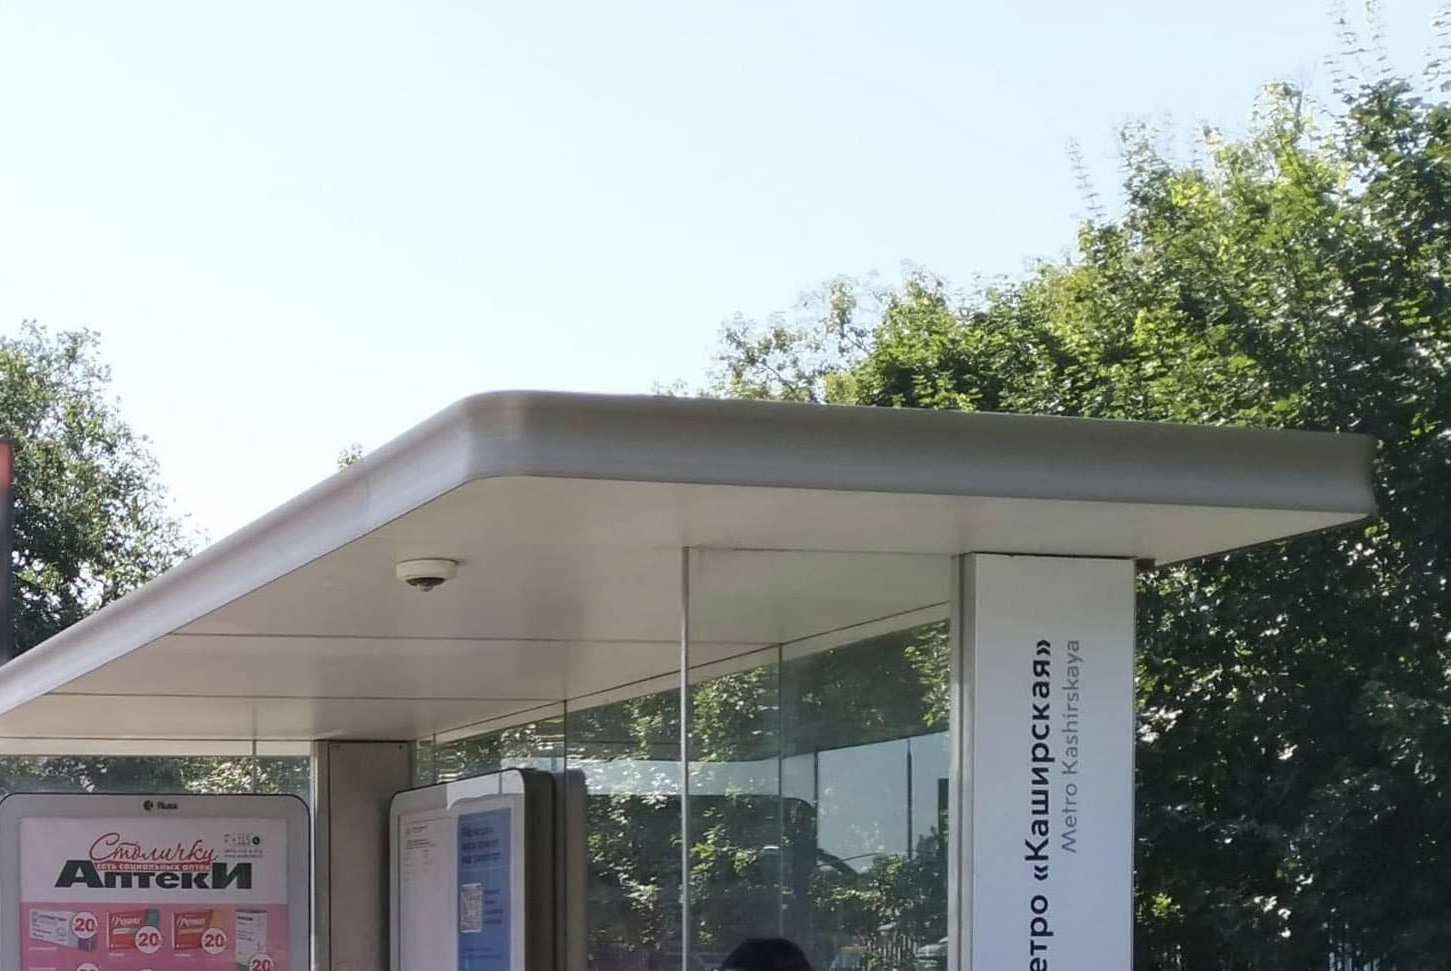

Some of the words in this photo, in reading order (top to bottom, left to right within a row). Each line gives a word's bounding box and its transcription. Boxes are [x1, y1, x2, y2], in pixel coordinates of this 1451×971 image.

[1061, 639, 1083, 775] Kashirskaya
[1024, 639, 1055, 881] «Каширская»
[1061, 783, 1078, 853] Metro
[119, 863, 181, 872] социальных
[75, 919, 95, 932] 20
[138, 933, 159, 946] 20
[205, 934, 225, 947] 20
